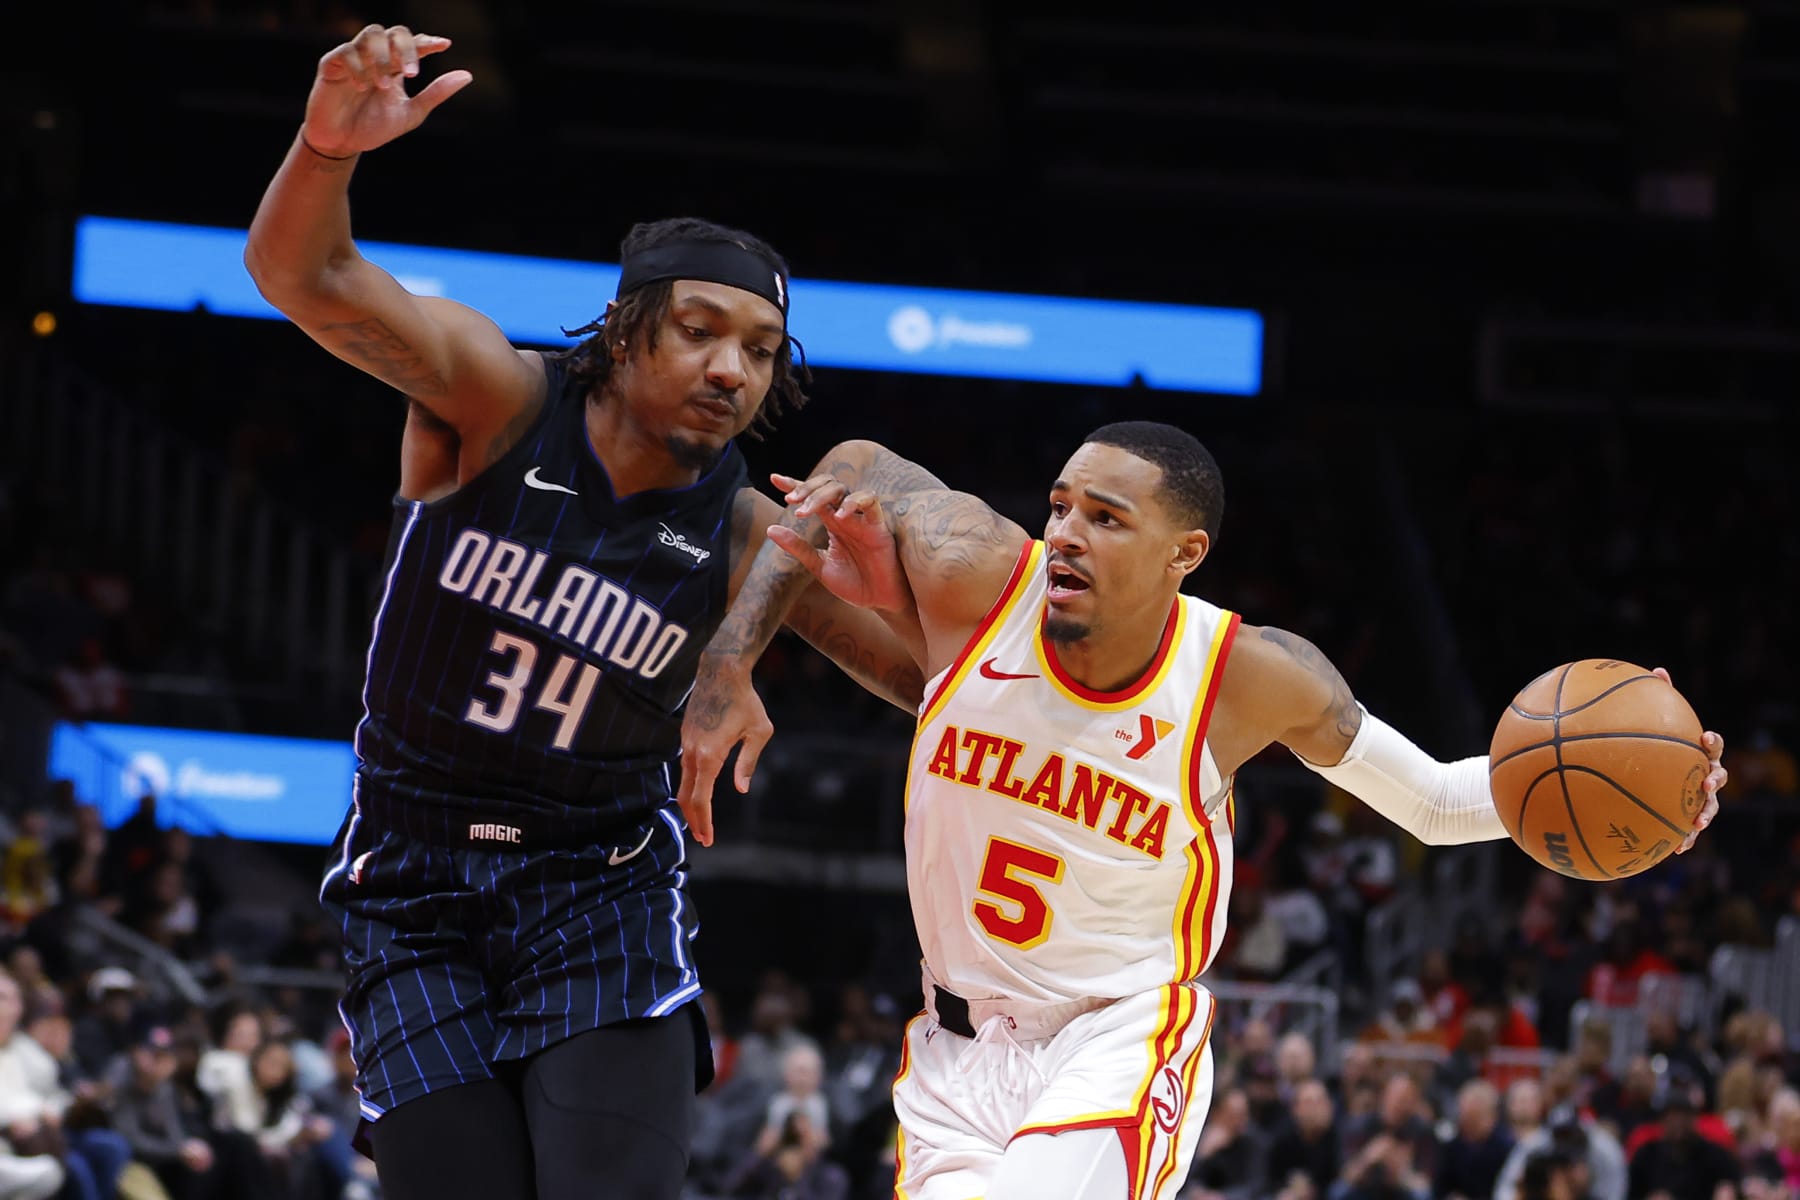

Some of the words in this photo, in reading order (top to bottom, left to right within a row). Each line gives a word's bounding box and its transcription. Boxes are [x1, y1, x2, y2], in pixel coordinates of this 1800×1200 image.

[439, 528, 688, 679] ORLANDO
[464, 630, 602, 751] 34
[1114, 729, 1133, 742] the
[470, 824, 522, 843] MAGIC
[928, 725, 1173, 862] ATLANTA
[971, 835, 1066, 950] 5
